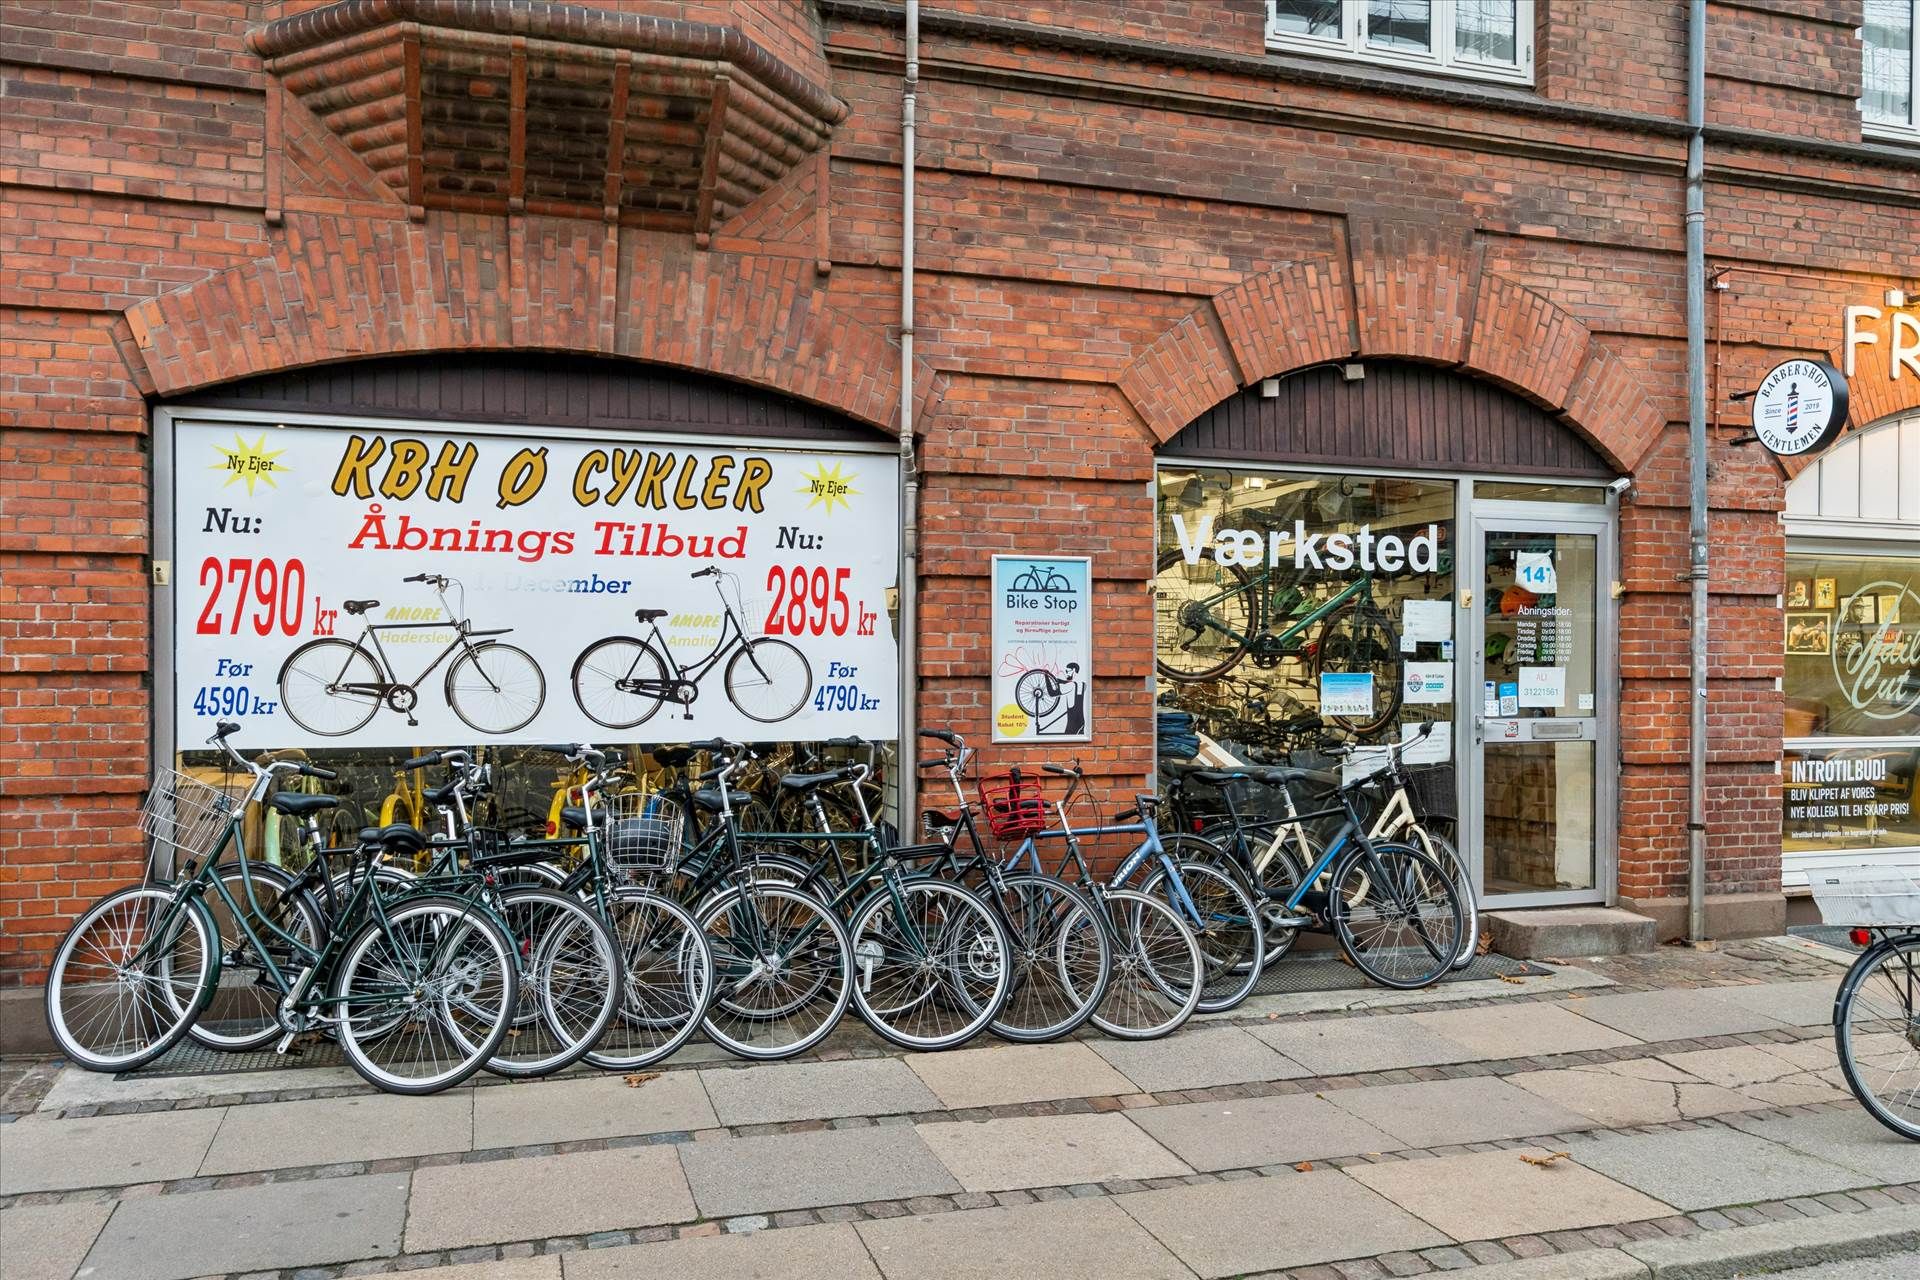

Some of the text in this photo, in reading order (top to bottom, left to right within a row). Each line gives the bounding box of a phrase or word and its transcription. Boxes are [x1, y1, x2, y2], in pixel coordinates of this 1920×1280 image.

[1804, 402, 1820, 410] 2019
[1762, 423, 1822, 451] GENTLEMEN
[227, 456, 274, 473] Ny Ejer
[331, 434, 774, 514] KBH Ø CYKLER
[810, 480, 848, 494] Ny Ejer
[202, 507, 263, 534] Nu:
[348, 502, 749, 563] Åbnings Tilbud
[775, 525, 824, 550] Nu:
[1172, 514, 1438, 573] Værksted
[196, 556, 338, 637] 2790 kr
[763, 564, 877, 637] 2895 kr
[1006, 594, 1077, 613] Bike Stop
[384, 606, 443, 621] AMORE
[669, 613, 721, 628] AMORE
[1517, 604, 1573, 618] Åbningstider:
[380, 630, 454, 643] Haderslev
[667, 635, 717, 647] Amalia
[215, 659, 253, 677] Før
[828, 662, 858, 678] Før
[1851, 659, 1911, 709] Cut
[193, 685, 278, 716] 4590 kr
[814, 685, 880, 712] 4790 kr
[1791, 759, 1886, 783] INTROTILBUD!
[1791, 786, 1875, 801] BLIV KLIPPET AF VORES
[1790, 802, 1909, 819] NYE KOLLEGA TIL EN SKARP PRIS!
